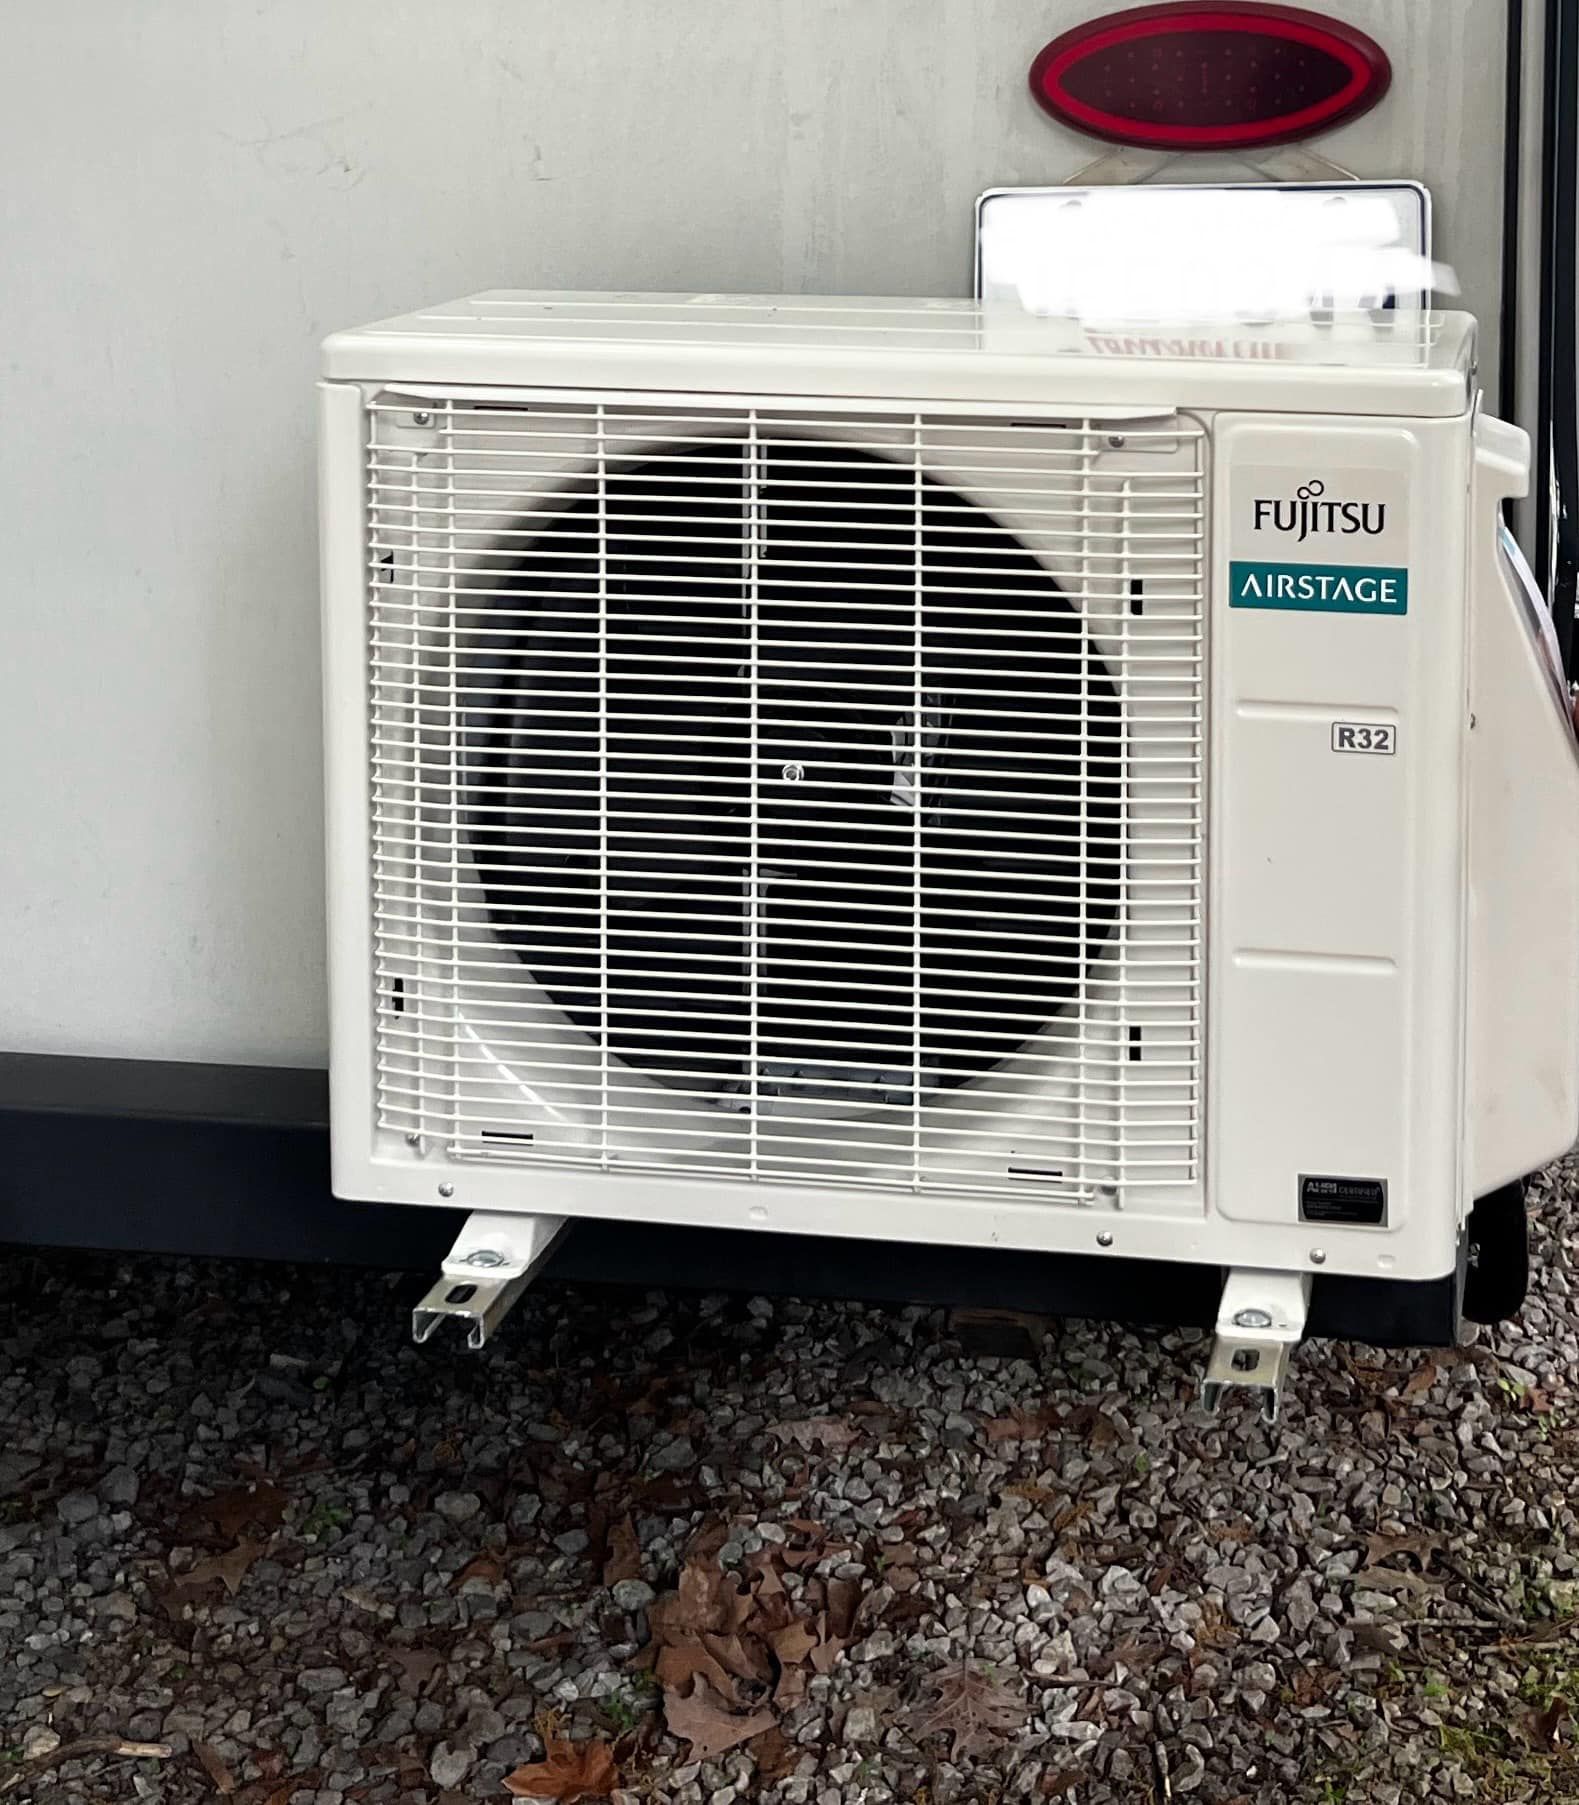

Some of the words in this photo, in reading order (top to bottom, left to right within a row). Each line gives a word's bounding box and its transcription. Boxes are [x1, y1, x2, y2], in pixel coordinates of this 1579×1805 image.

[1253, 499, 1386, 543] FUJITSU
[1240, 573, 1398, 604] AIRSTAGE
[1338, 727, 1389, 751] R32
